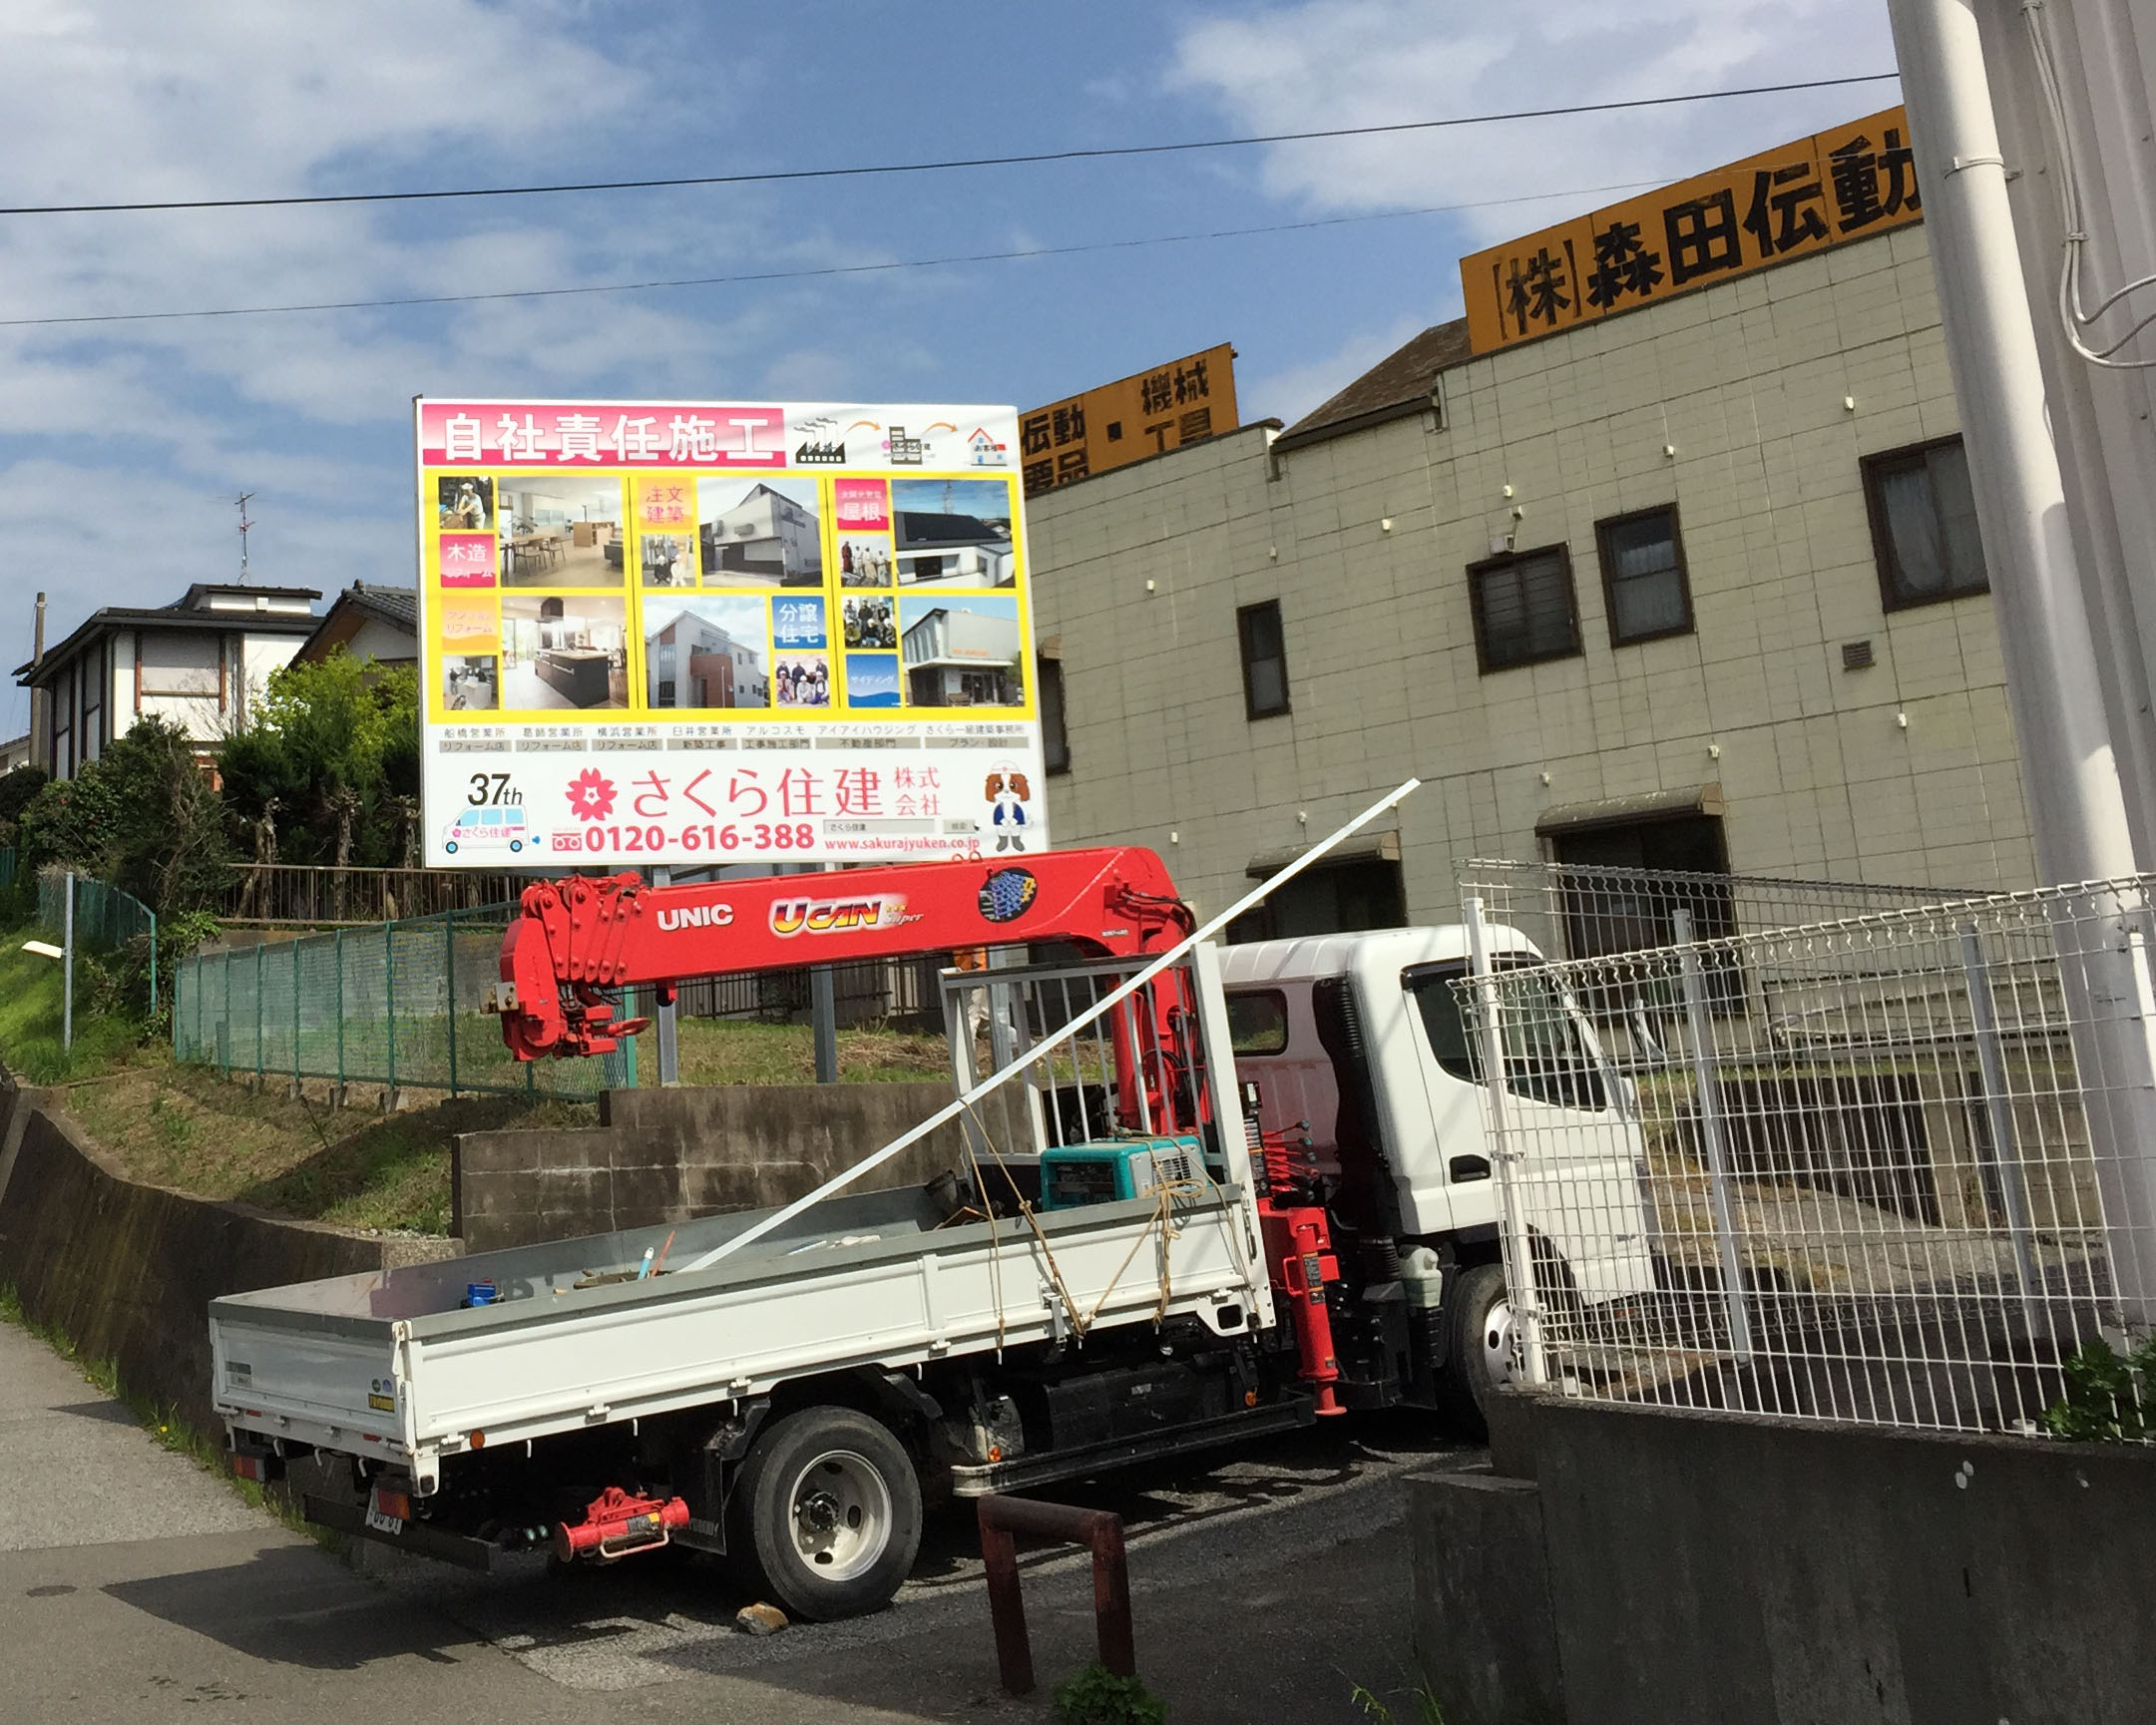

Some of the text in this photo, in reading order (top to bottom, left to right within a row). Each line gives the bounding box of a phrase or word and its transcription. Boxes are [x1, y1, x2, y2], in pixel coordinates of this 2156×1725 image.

[1141, 358, 1209, 415] 機械
[445, 412, 773, 462] 自社責任施工
[1022, 403, 1085, 456] 伝動
[647, 486, 684, 503] 注文
[647, 506, 684, 524] 建築
[447, 543, 488, 563] 木造
[447, 624, 493, 634] リフォーム
[780, 624, 819, 644] 住宅
[598, 726, 657, 737] 横浜営業所
[746, 725, 806, 735] アルコスモ
[818, 725, 918, 735] アイアイハウジング
[444, 741, 505, 752] リフォーム店
[522, 741, 584, 752] リフォーム店
[598, 740, 658, 750] リフォーム店
[682, 739, 726, 750] 新築工事
[839, 738, 897, 749] 不動産部門
[467, 772, 523, 806] 37th
[893, 766, 941, 789] 株式
[632, 767, 884, 818] さくら住建
[895, 793, 942, 816] 会社
[586, 823, 815, 852] 0120-616-388
[825, 837, 981, 852] www.sakurajyuken.co.jp
[657, 904, 734, 931] UNIC
